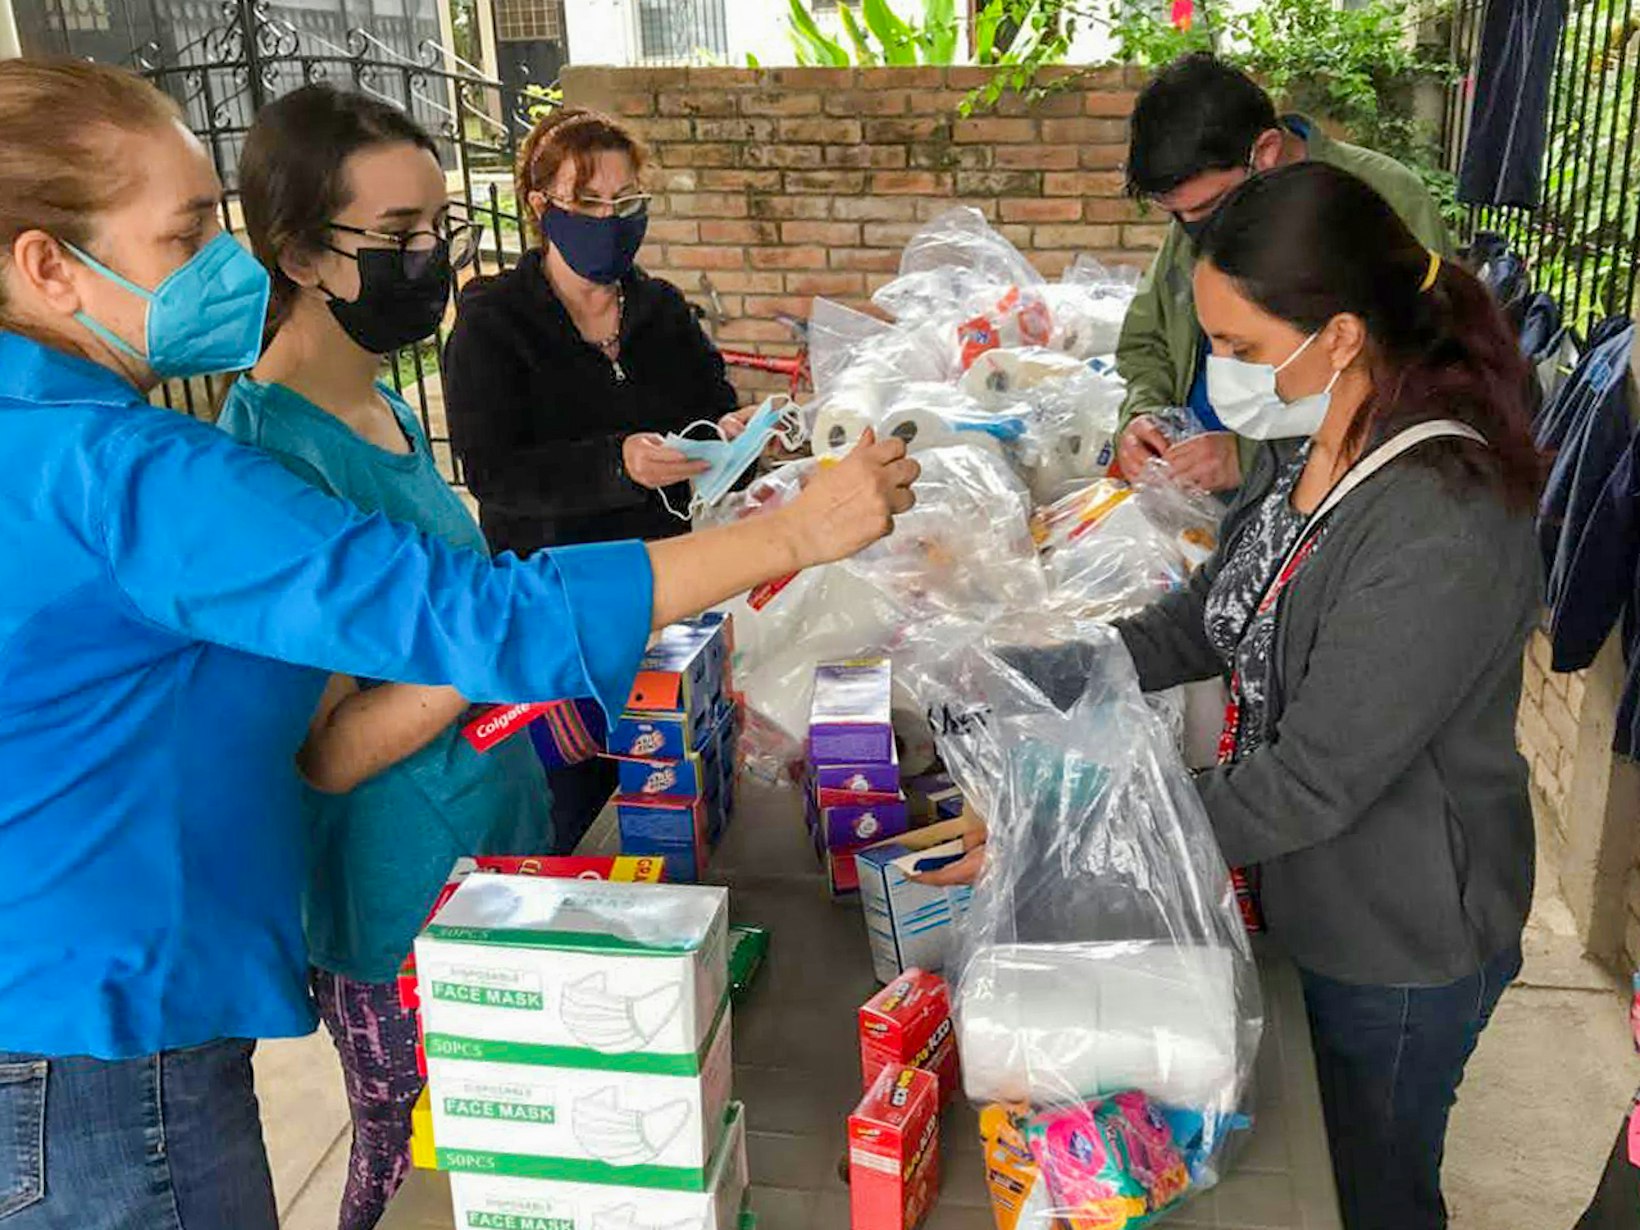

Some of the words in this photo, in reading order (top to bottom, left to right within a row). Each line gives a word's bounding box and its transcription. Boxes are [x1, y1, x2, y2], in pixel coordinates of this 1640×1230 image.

[476, 703, 530, 738] Colgate
[433, 983, 481, 1002] FACE
[486, 989, 540, 1007] MASK
[432, 1038, 483, 1056] 50PCS
[445, 1102, 494, 1116] FACE
[499, 1106, 552, 1121] MASK
[446, 1153, 495, 1168] 50PCS
[469, 1211, 519, 1229] FACE
[521, 1217, 574, 1230] MASK
